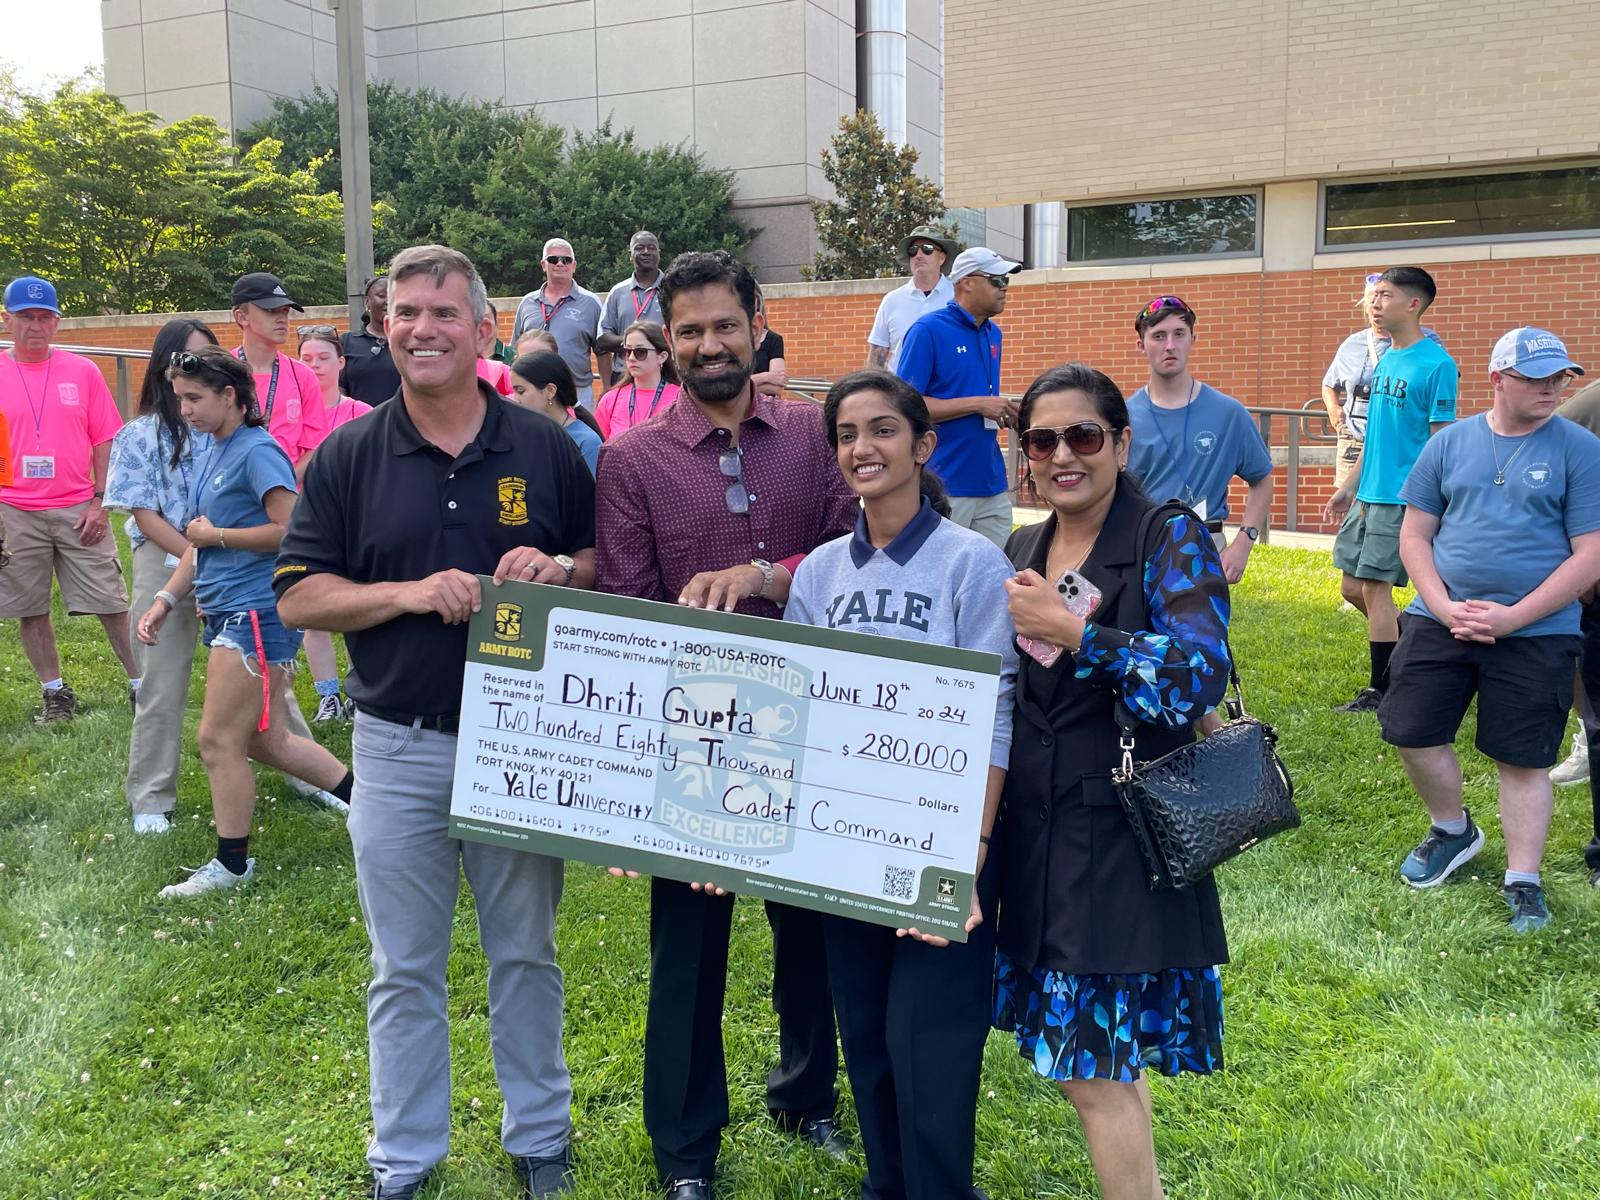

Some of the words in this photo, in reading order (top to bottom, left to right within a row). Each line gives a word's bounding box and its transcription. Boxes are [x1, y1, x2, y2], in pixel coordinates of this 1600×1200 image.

[825, 588, 932, 633] YALE
[479, 642, 507, 656] ARMY
[508, 646, 532, 660] ROTC
[553, 641, 582, 653] START
[583, 645, 620, 658] STRONG
[622, 651, 646, 663] WITH
[647, 656, 675, 667] ARMY
[677, 660, 702, 672] ROTC
[554, 624, 658, 649] goarmy.com/rotc
[672, 640, 787, 669] 1-800-USA-ROTC
[483, 685, 500, 696] the
[502, 689, 531, 701] name
[534, 693, 544, 703] of
[484, 672, 532, 689] Reserved
[534, 680, 544, 690] in
[935, 676, 950, 686] No.
[953, 678, 975, 690] 7675
[562, 673, 643, 716] Dhriti
[662, 686, 756, 735] Gupta
[918, 707, 934, 719] 20
[938, 705, 966, 722] 24
[535, 706, 603, 744] hundred
[616, 724, 678, 771] Eighty
[699, 737, 795, 780] Thousand
[842, 743, 849, 757] $
[857, 732, 968, 774] 280,000
[476, 755, 502, 768] FORT
[505, 761, 538, 775] KNOX,
[541, 767, 556, 778] KY
[558, 769, 592, 784] 40121
[478, 739, 498, 751] THE
[501, 743, 520, 755] U.S.
[524, 748, 555, 761] ARMY
[558, 754, 594, 768] CADET
[597, 760, 653, 778] COMMAND
[472, 782, 489, 794] For
[503, 771, 548, 800] Yale
[722, 785, 796, 824] Cadet
[811, 800, 934, 851] Command
[918, 796, 960, 814] Dollars
[663, 801, 784, 845] EXCELLENCE
[839, 897, 854, 907] UNITED
[855, 901, 868, 910] STATES
[868, 904, 895, 916] GOVERNMENT
[896, 909, 915, 920] PRINTING
